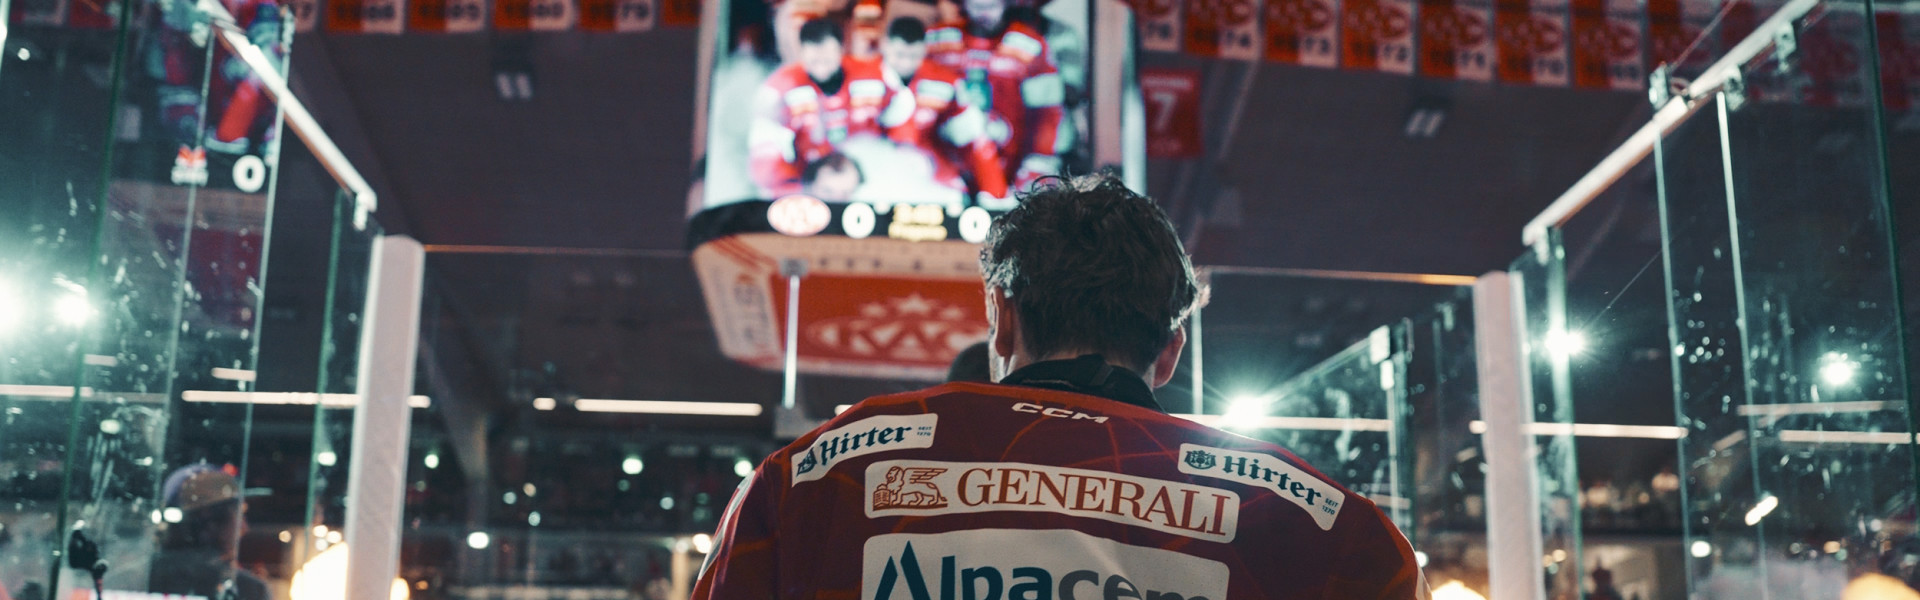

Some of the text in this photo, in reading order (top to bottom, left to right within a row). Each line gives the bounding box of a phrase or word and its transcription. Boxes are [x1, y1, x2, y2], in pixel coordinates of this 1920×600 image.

[1151, 92, 1176, 132] 7
[232, 155, 265, 193] 0
[842, 202, 876, 238] 0
[959, 206, 992, 243] 0
[1011, 402, 1109, 424] CCM
[819, 426, 912, 466] Hirter
[1223, 455, 1322, 506] Hirter
[957, 468, 1231, 536] GENERALI
[1322, 505, 1335, 514] 1270
[1325, 498, 1338, 508] SEIT
